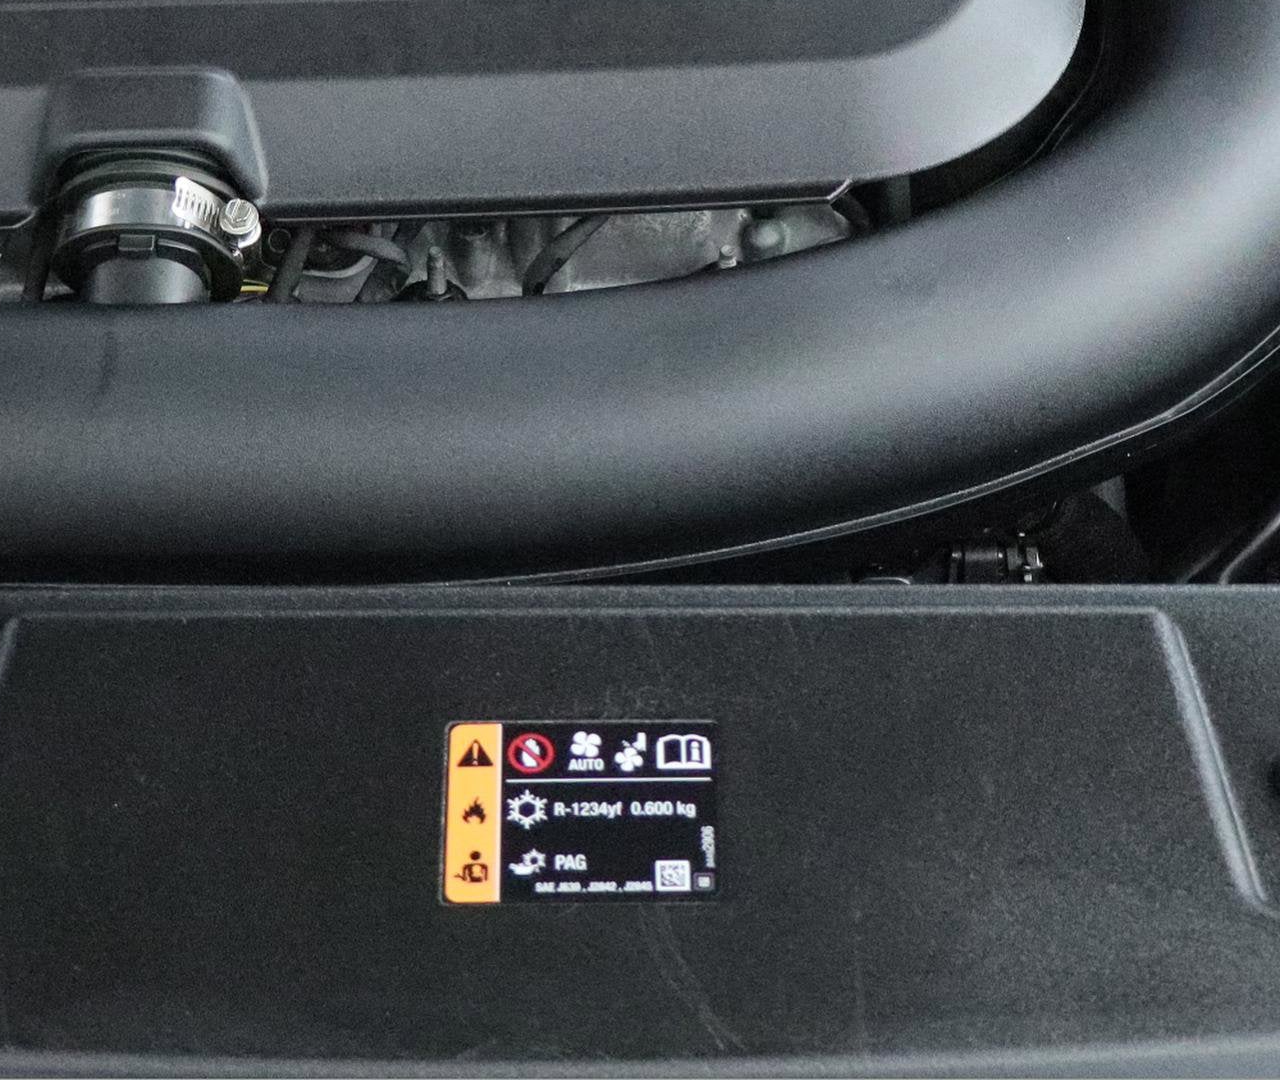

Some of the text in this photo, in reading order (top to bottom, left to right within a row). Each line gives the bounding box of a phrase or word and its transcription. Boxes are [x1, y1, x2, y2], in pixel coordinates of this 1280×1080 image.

[568, 758, 605, 772] AUTO
[554, 801, 696, 818] R-1234yf 0.600 kg
[554, 854, 587, 871] PAG
[535, 881, 556, 893] SAE
